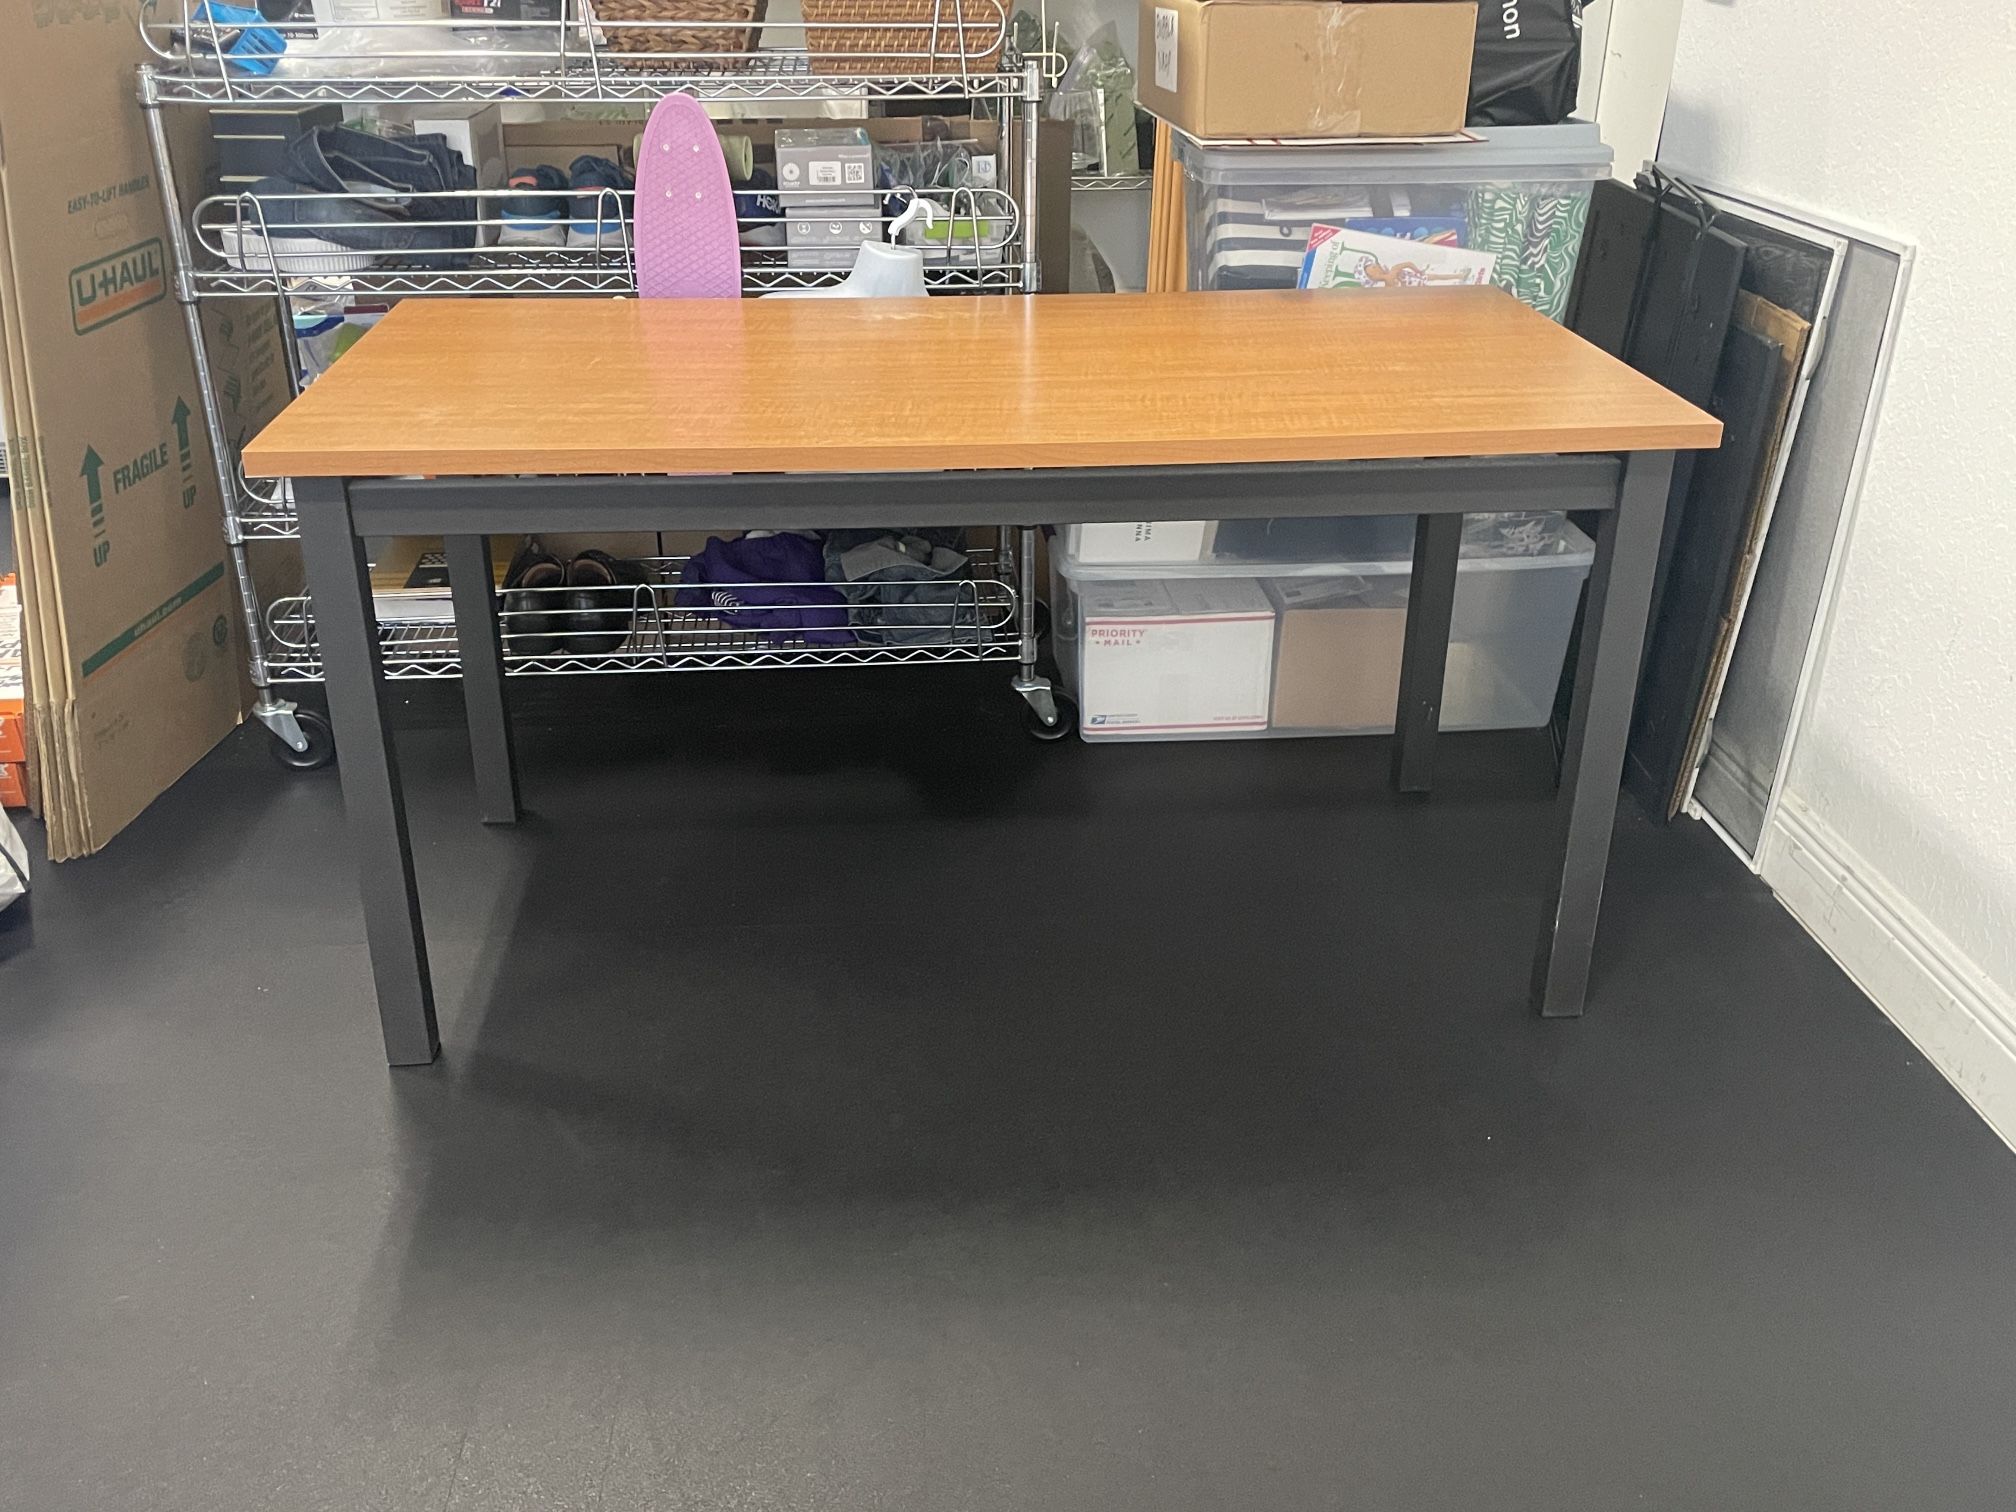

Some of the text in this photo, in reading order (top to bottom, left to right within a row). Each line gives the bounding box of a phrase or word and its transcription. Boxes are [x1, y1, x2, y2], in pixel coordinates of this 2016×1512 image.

[76, 251, 160, 307] U-HAUL
[112, 442, 169, 494] FRAGILE
[182, 484, 197, 510] UP
[93, 540, 111, 568] UP
[1090, 629, 1146, 638] PRIORITY
